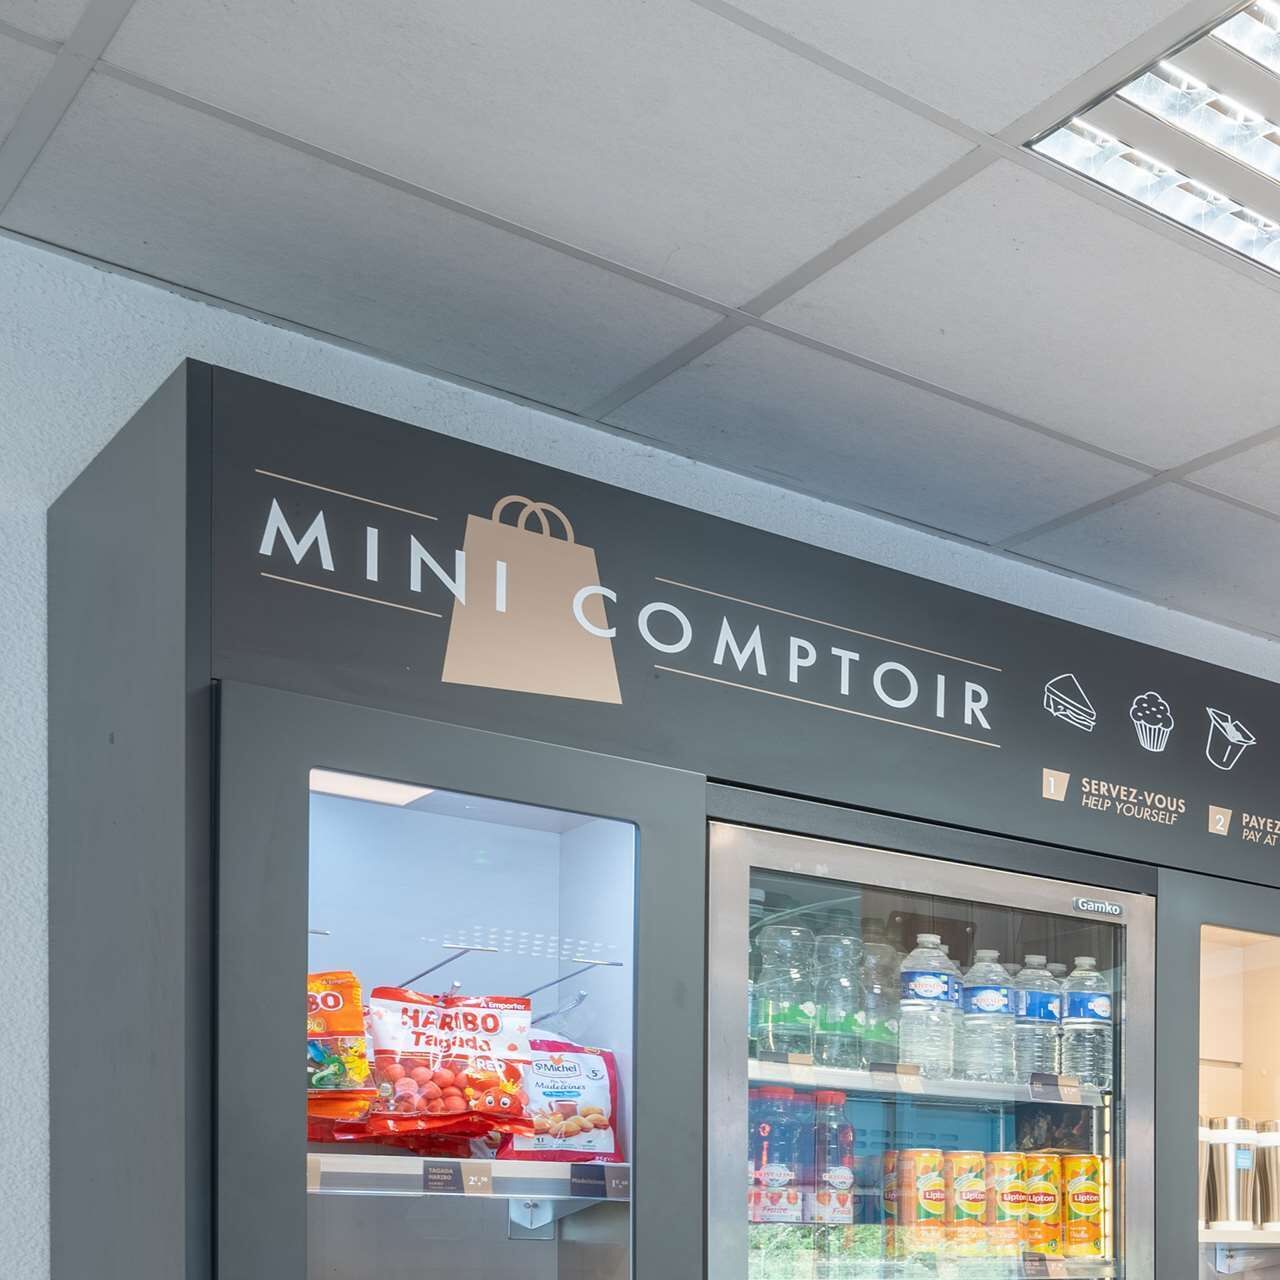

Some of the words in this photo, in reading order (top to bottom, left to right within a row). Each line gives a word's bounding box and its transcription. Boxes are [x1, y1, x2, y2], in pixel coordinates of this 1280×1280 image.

[258, 497, 508, 613] MINI
[572, 584, 992, 730] COMPTOIR
[1047, 776, 1056, 795] 1
[1081, 777, 1186, 813] SERVEZ-VOUS
[1081, 794, 1112, 812] HELP
[1115, 801, 1178, 825] YOURSELF
[1215, 814, 1226, 831] 2
[1242, 828, 1262, 843] PAY
[1264, 834, 1278, 847] AT
[1078, 898, 1120, 915] Gamko
[400, 1006, 500, 1034] HARIBO
[411, 1030, 491, 1053] Tagada
[544, 1062, 577, 1073] Michel
[1028, 1194, 1055, 1204] Lipton
[1074, 1193, 1100, 1203] Lipton
